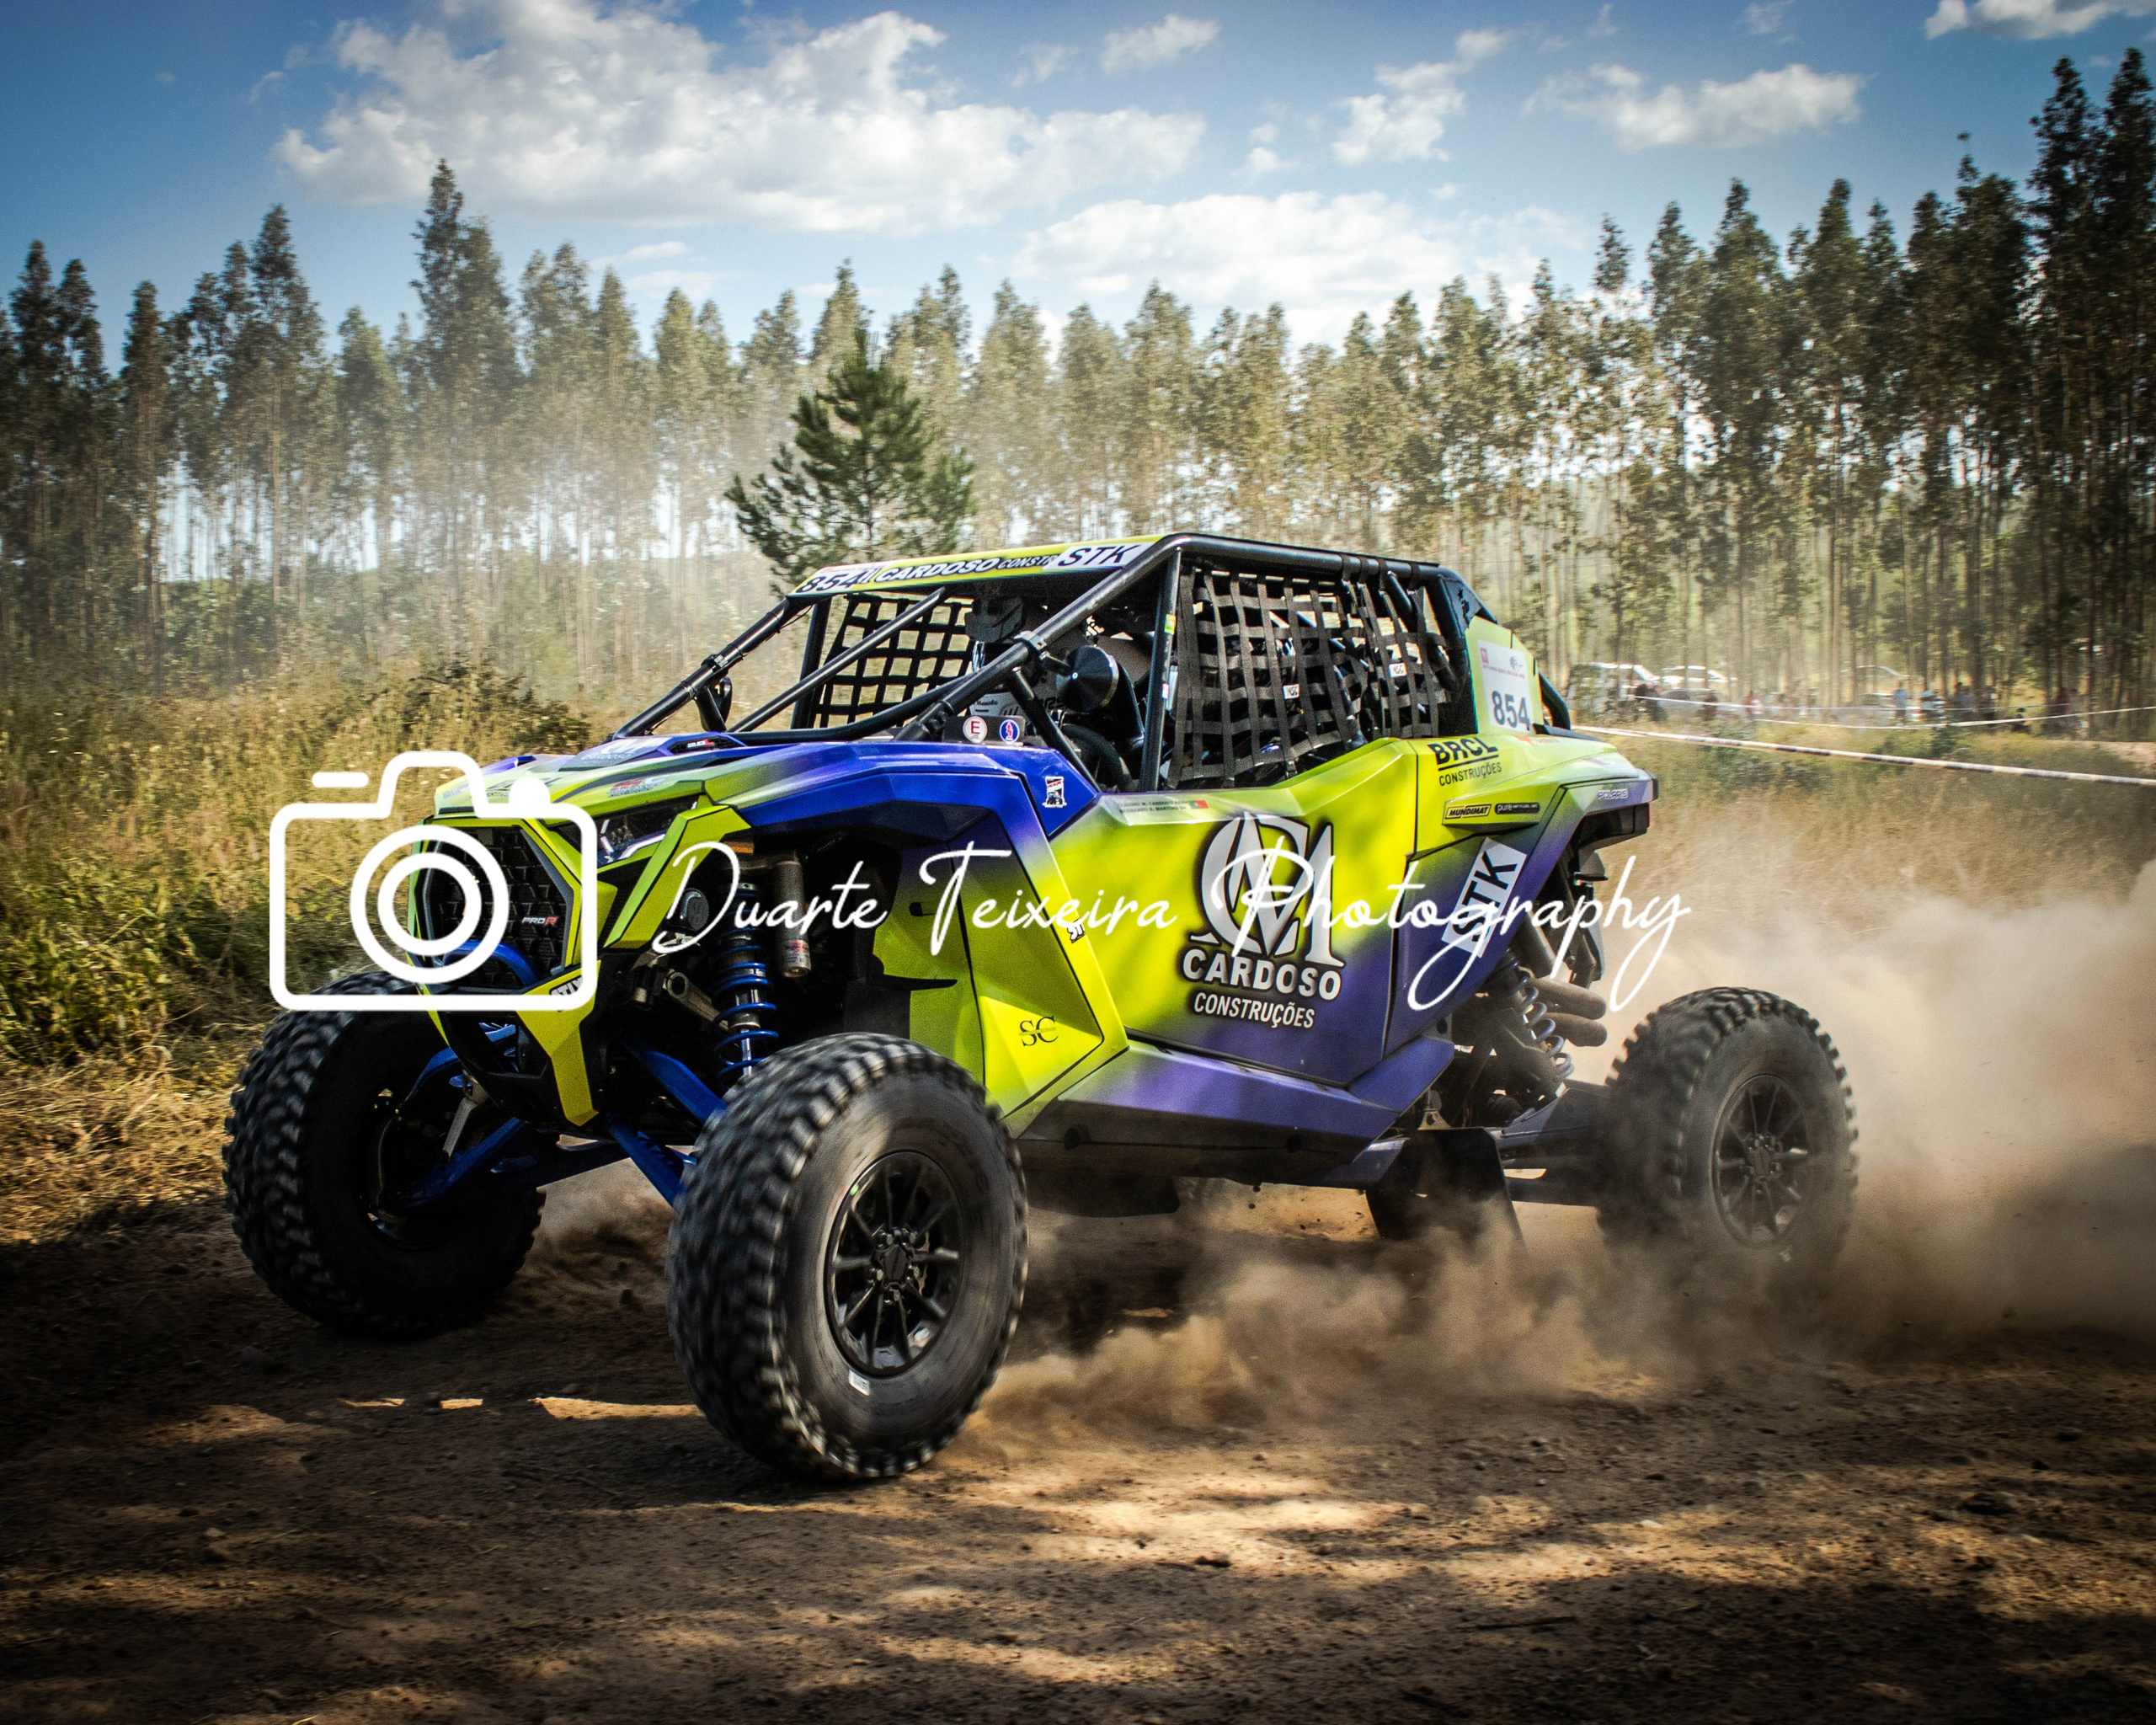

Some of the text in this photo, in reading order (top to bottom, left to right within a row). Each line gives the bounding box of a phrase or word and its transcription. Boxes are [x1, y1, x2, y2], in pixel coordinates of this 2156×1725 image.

[1059, 544, 1139, 565] STK
[796, 570, 869, 593] 854
[874, 557, 999, 583] CARDOSO
[1492, 690, 1530, 731] 854
[970, 721, 980, 734] E
[1428, 736, 1498, 765] BRCL
[1438, 761, 1502, 786] CONSTRUÇÕES
[1449, 806, 1488, 816] MUNDIMAT
[1182, 948, 1342, 1001] CARDOSO
[1194, 992, 1315, 1028] CONSTRUÇÕES
[1019, 1015, 1059, 1047] SC
